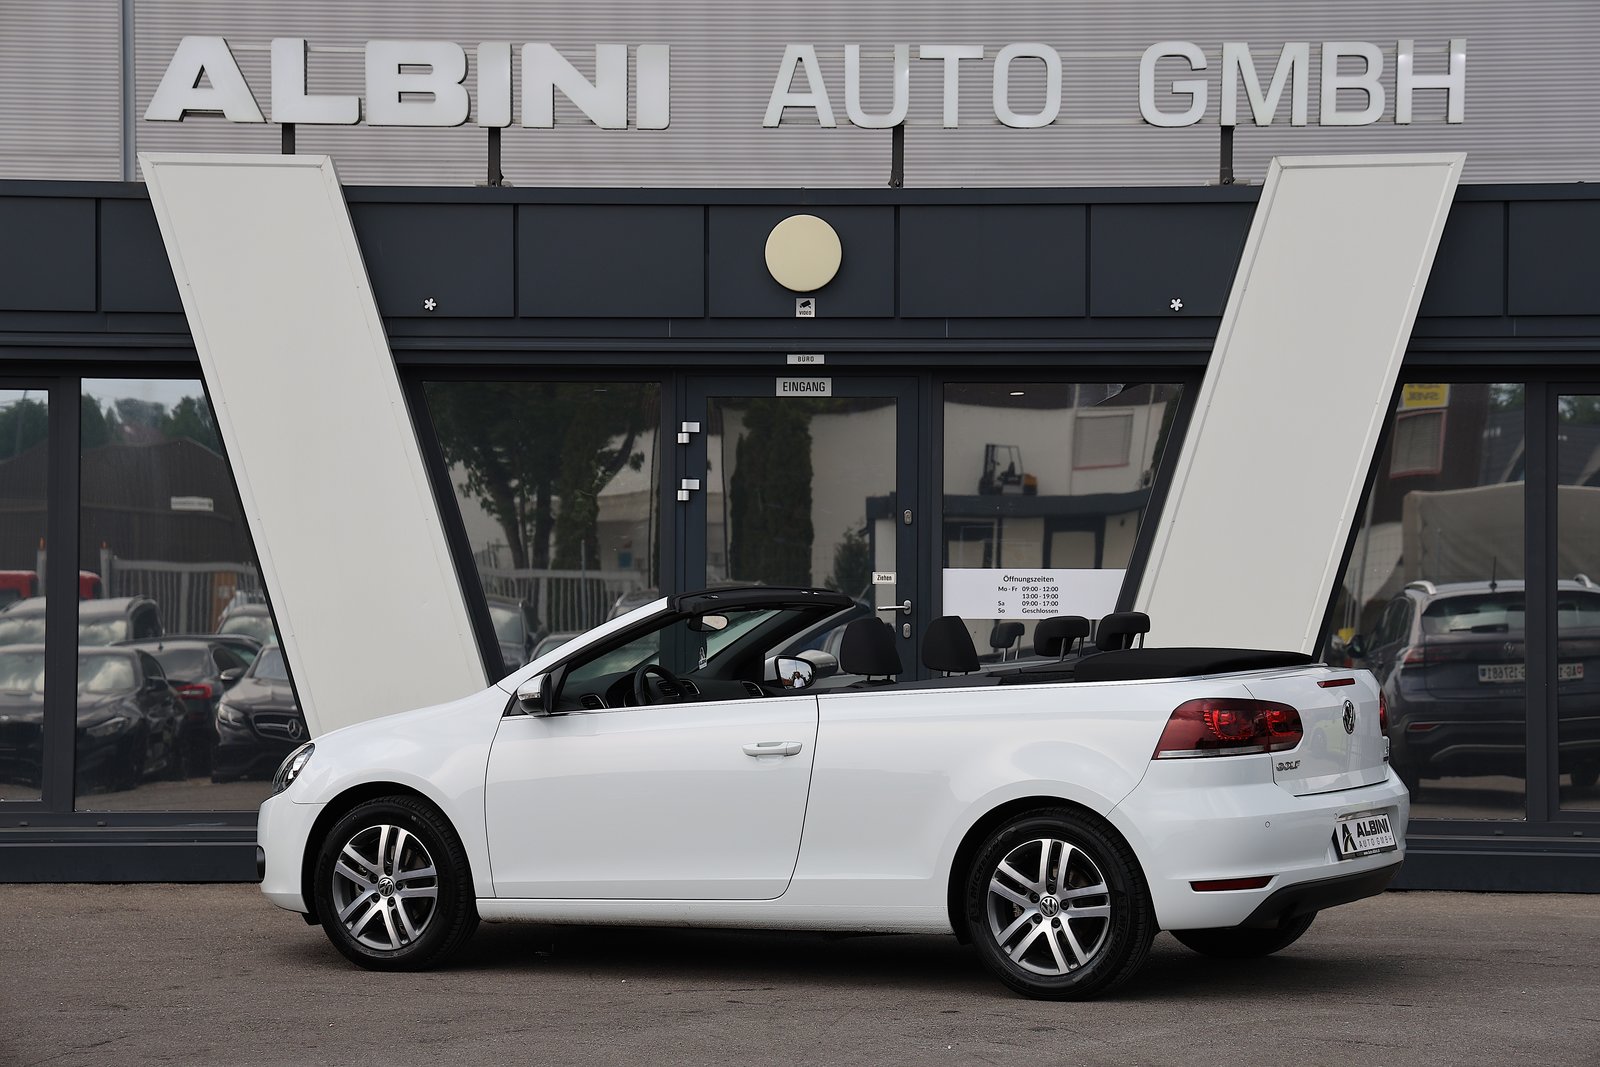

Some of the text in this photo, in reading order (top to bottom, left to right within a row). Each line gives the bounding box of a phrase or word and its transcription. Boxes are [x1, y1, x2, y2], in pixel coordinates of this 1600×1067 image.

[143, 36, 1467, 130] ALBINI AUTO GMBH
[797, 354, 815, 362] BÜRO
[782, 381, 826, 392] EINGANG
[1003, 575, 1054, 583] Öffnungszeiten
[1276, 759, 1301, 772] GOLF
[1356, 817, 1390, 838] ALBINI
[1358, 837, 1376, 849] AUTO
